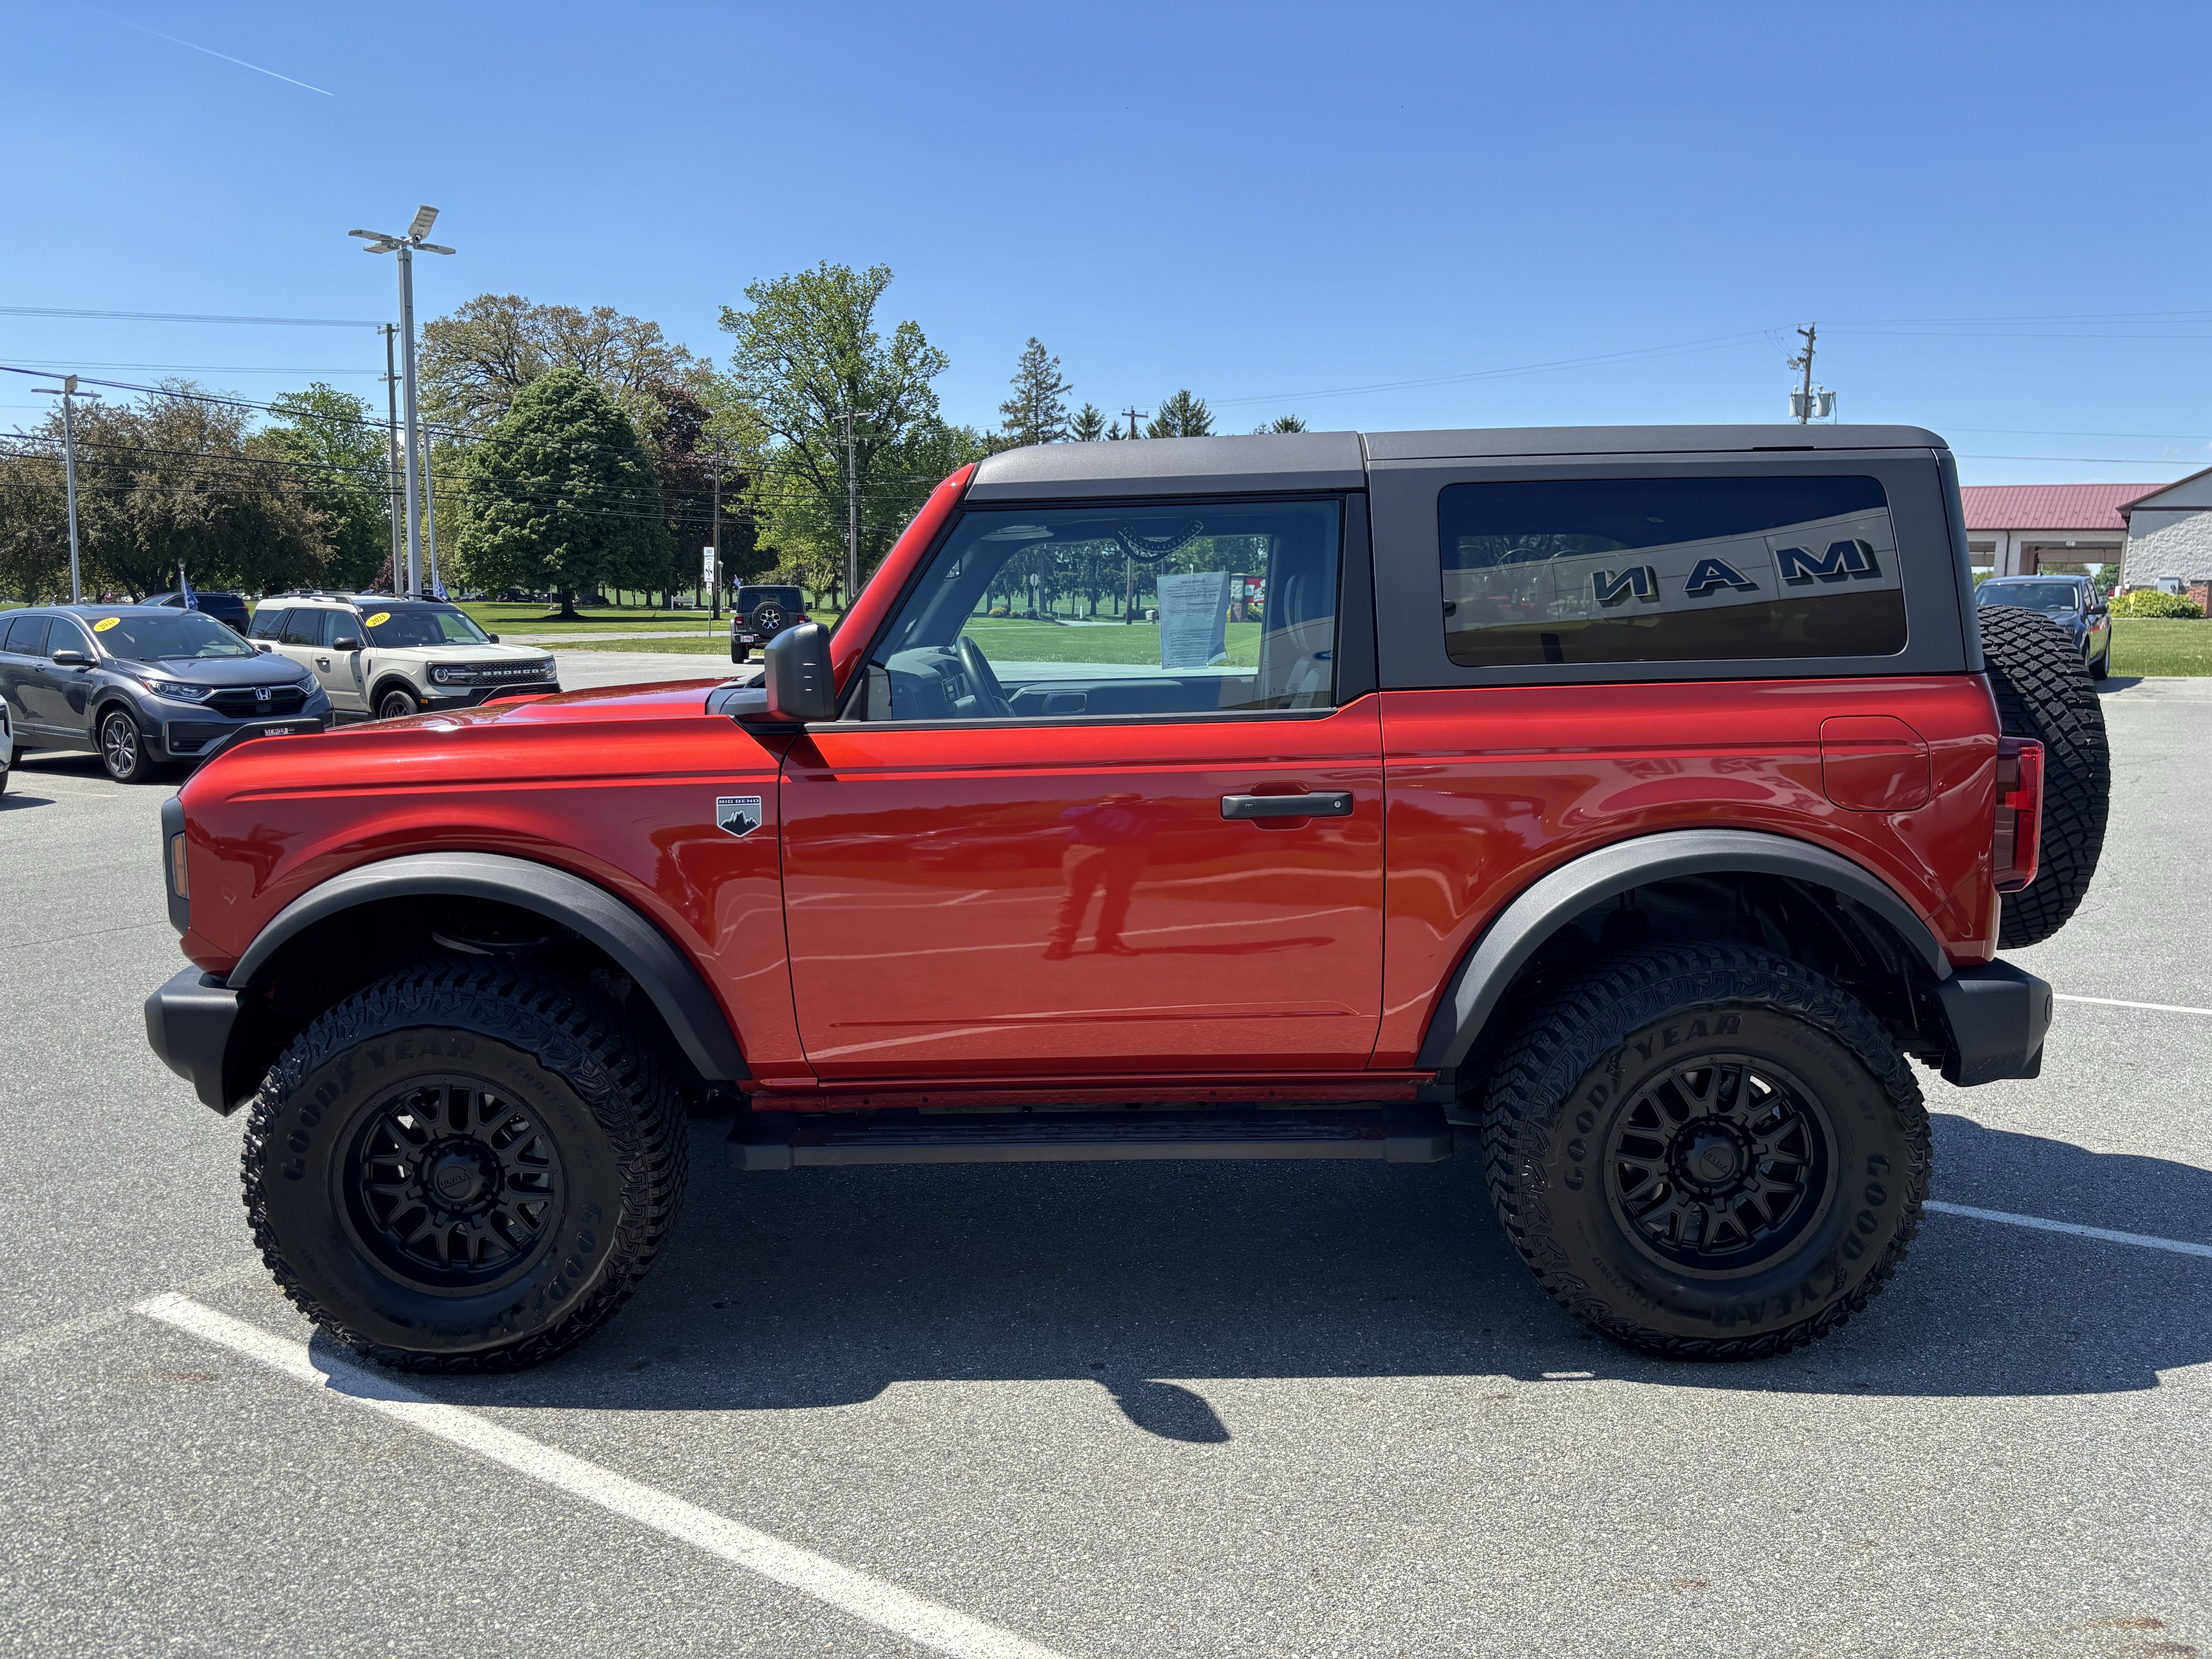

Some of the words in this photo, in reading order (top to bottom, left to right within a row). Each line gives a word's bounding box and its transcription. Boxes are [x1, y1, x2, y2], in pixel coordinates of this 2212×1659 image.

[98, 619, 115, 630] 2022
[370, 614, 386, 625] 2025
[1703, 1151, 1727, 1173] ULTRA
[440, 1173, 471, 1187] ULTRA
